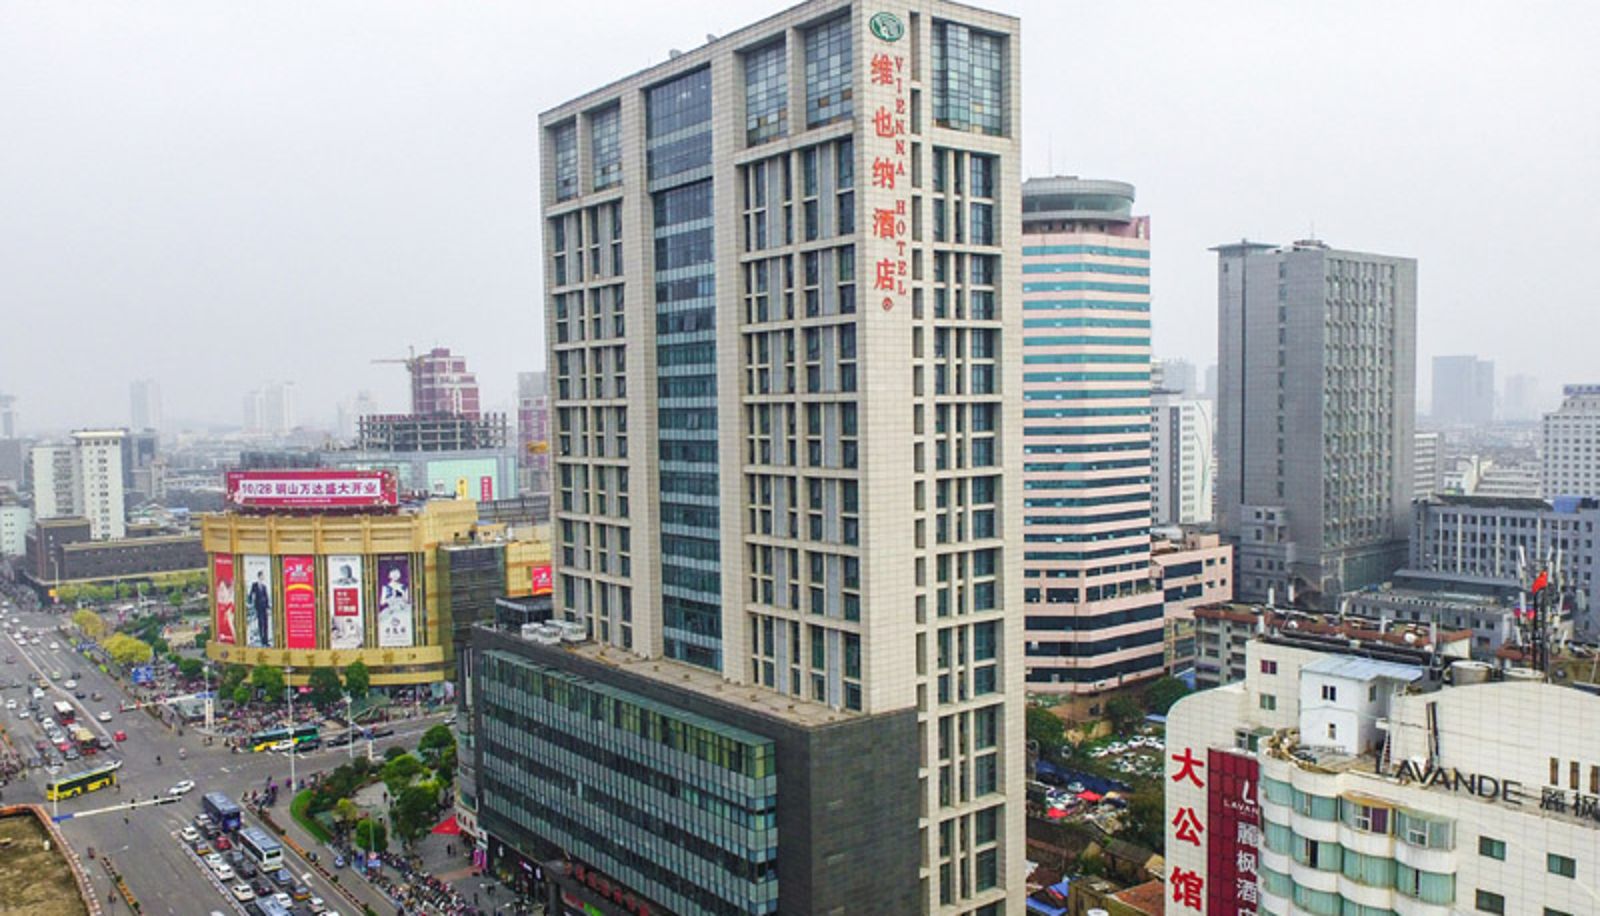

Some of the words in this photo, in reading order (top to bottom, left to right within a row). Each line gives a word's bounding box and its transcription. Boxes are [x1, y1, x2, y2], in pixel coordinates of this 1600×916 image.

[871, 53, 896, 291] 维也纳酒店
[895, 57, 906, 175] VIENNA
[896, 200, 907, 295] HOTEL
[1170, 748, 1205, 912] 大公馆
